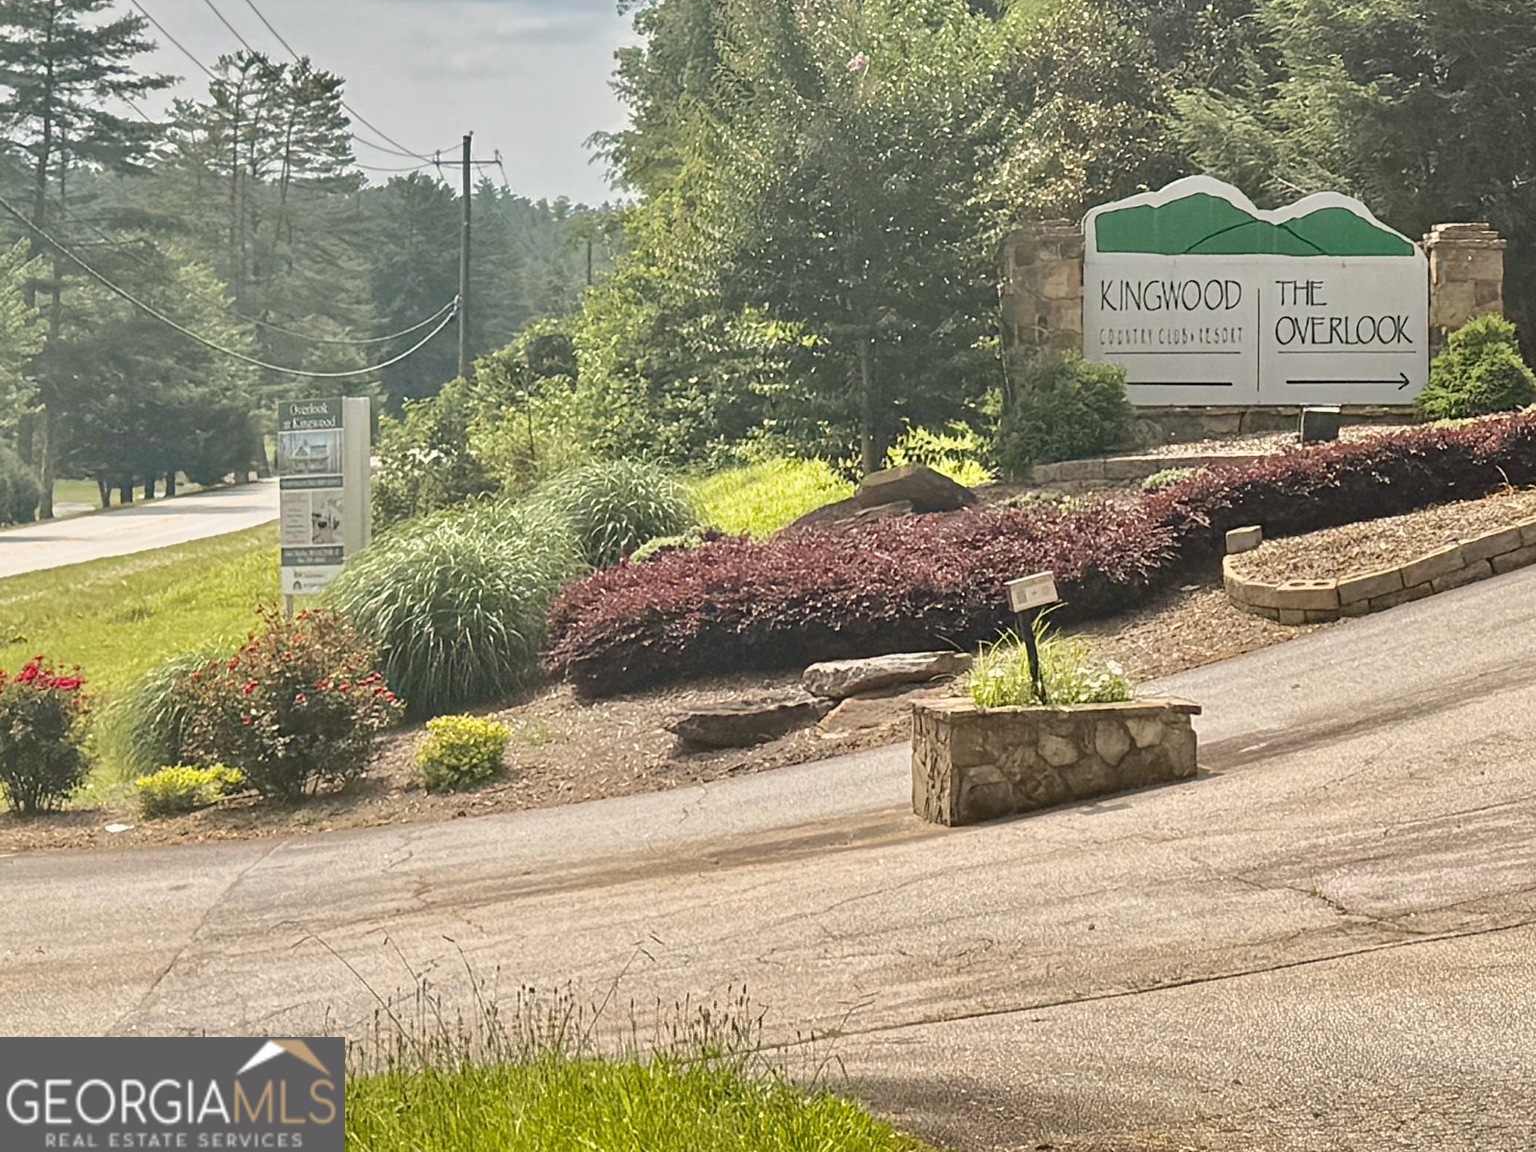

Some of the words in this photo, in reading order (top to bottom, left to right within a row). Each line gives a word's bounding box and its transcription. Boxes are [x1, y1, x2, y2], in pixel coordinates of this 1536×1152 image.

[1100, 279, 1242, 311] KINGWOOD
[1275, 280, 1327, 306] THE
[1099, 328, 1153, 345] COUNTRY
[1158, 327, 1188, 345] CLUB
[1199, 327, 1243, 345] RESORT
[1275, 315, 1413, 345] OVERLOOK
[290, 402, 329, 416] Overlook
[293, 414, 336, 429] Kingwood
